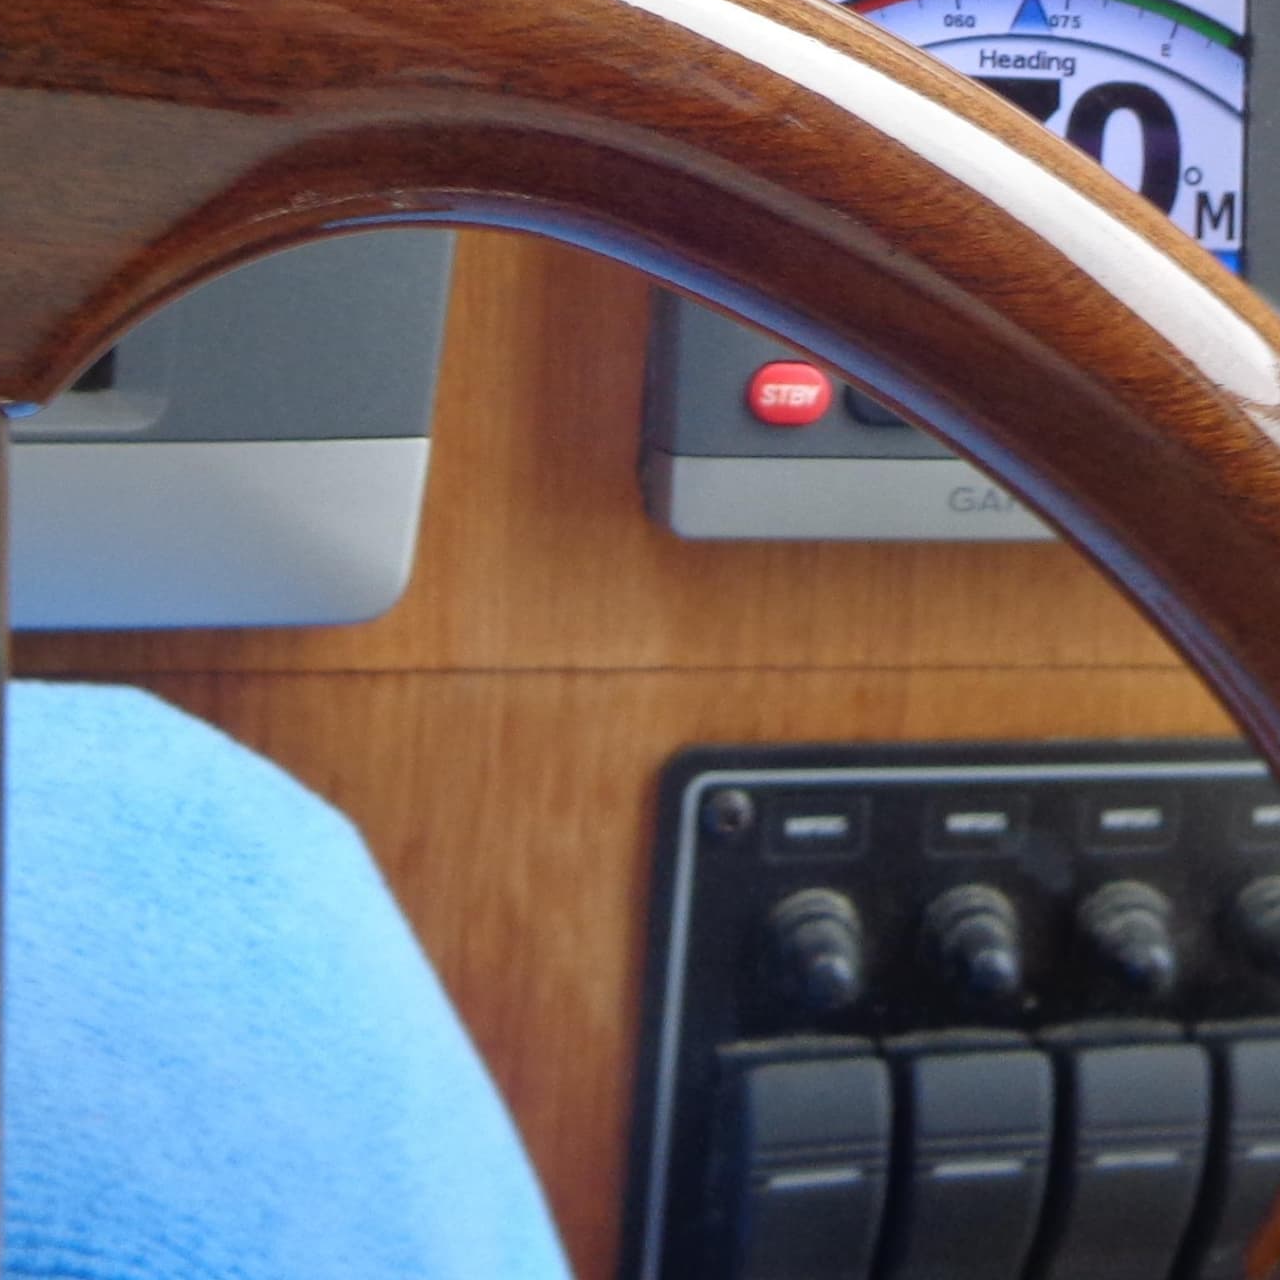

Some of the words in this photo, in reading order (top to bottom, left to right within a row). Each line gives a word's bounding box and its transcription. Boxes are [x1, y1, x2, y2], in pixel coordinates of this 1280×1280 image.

[943, 13, 976, 29] 060
[1047, 13, 1081, 30] 075
[978, 48, 1077, 78] Heading
[760, 382, 822, 408] STBY
